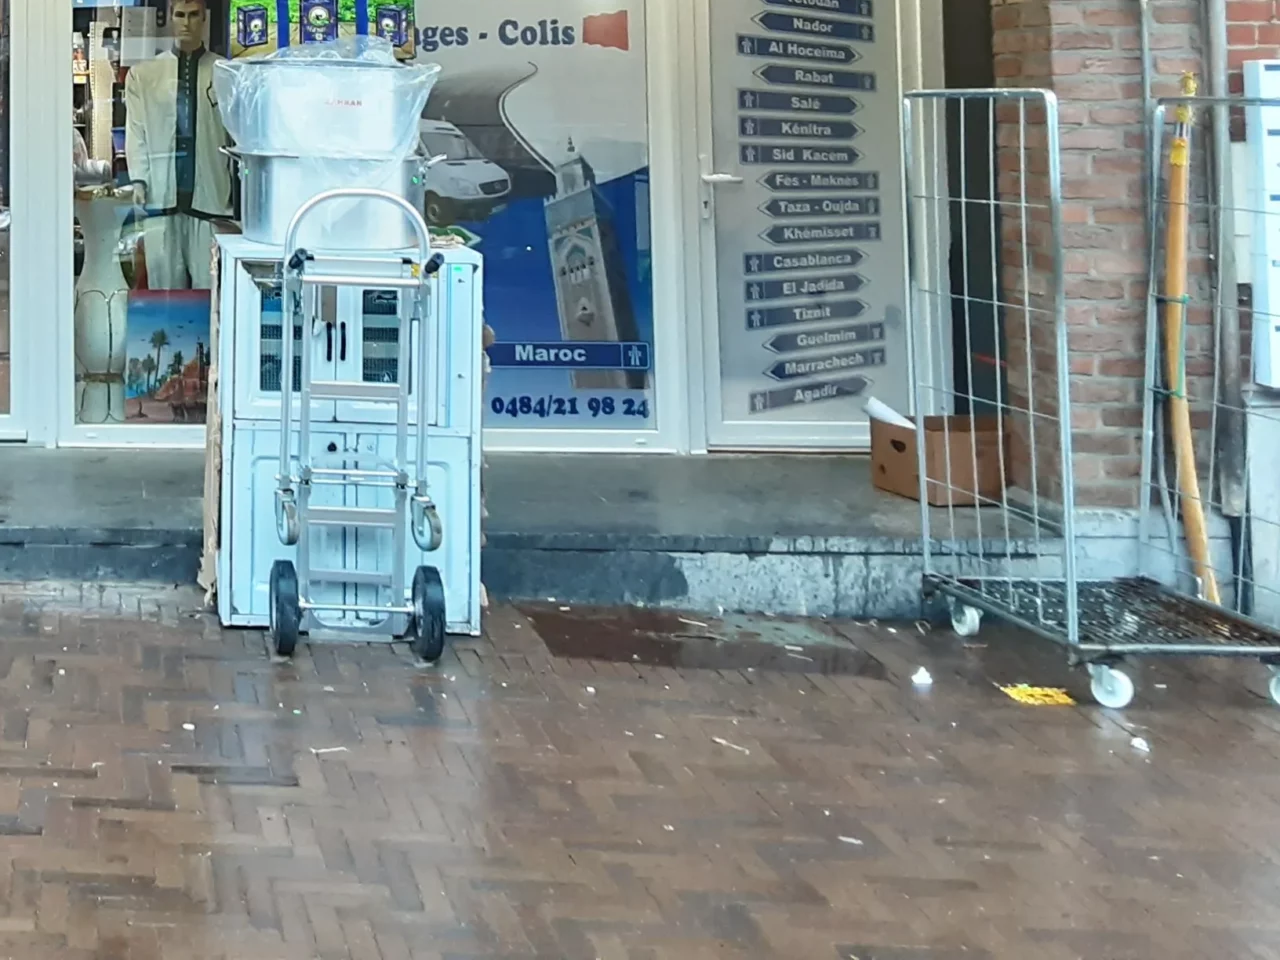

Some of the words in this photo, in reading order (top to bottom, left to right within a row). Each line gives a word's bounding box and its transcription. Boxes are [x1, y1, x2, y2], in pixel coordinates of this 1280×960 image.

[498, 19, 575, 45] Colis
[793, 17, 834, 33] Nador
[769, 41, 783, 54] Al
[795, 69, 834, 84] Rabat
[791, 97, 821, 110] Salé
[781, 122, 832, 136] Kénitra
[772, 148, 795, 161] Sid
[802, 149, 849, 162] Kacem
[778, 200, 811, 213] Taza
[822, 200, 860, 214] Oujda
[772, 254, 852, 268] Casablanca
[782, 282, 797, 295] El
[800, 279, 845, 294] Jadida
[793, 307, 831, 322] Tiznit
[515, 345, 587, 362] Maroc
[784, 353, 865, 375] Marrachech
[793, 384, 838, 403] Agadir
[491, 395, 578, 417] 0484/21
[588, 397, 615, 417] 98
[622, 398, 649, 418] 24
